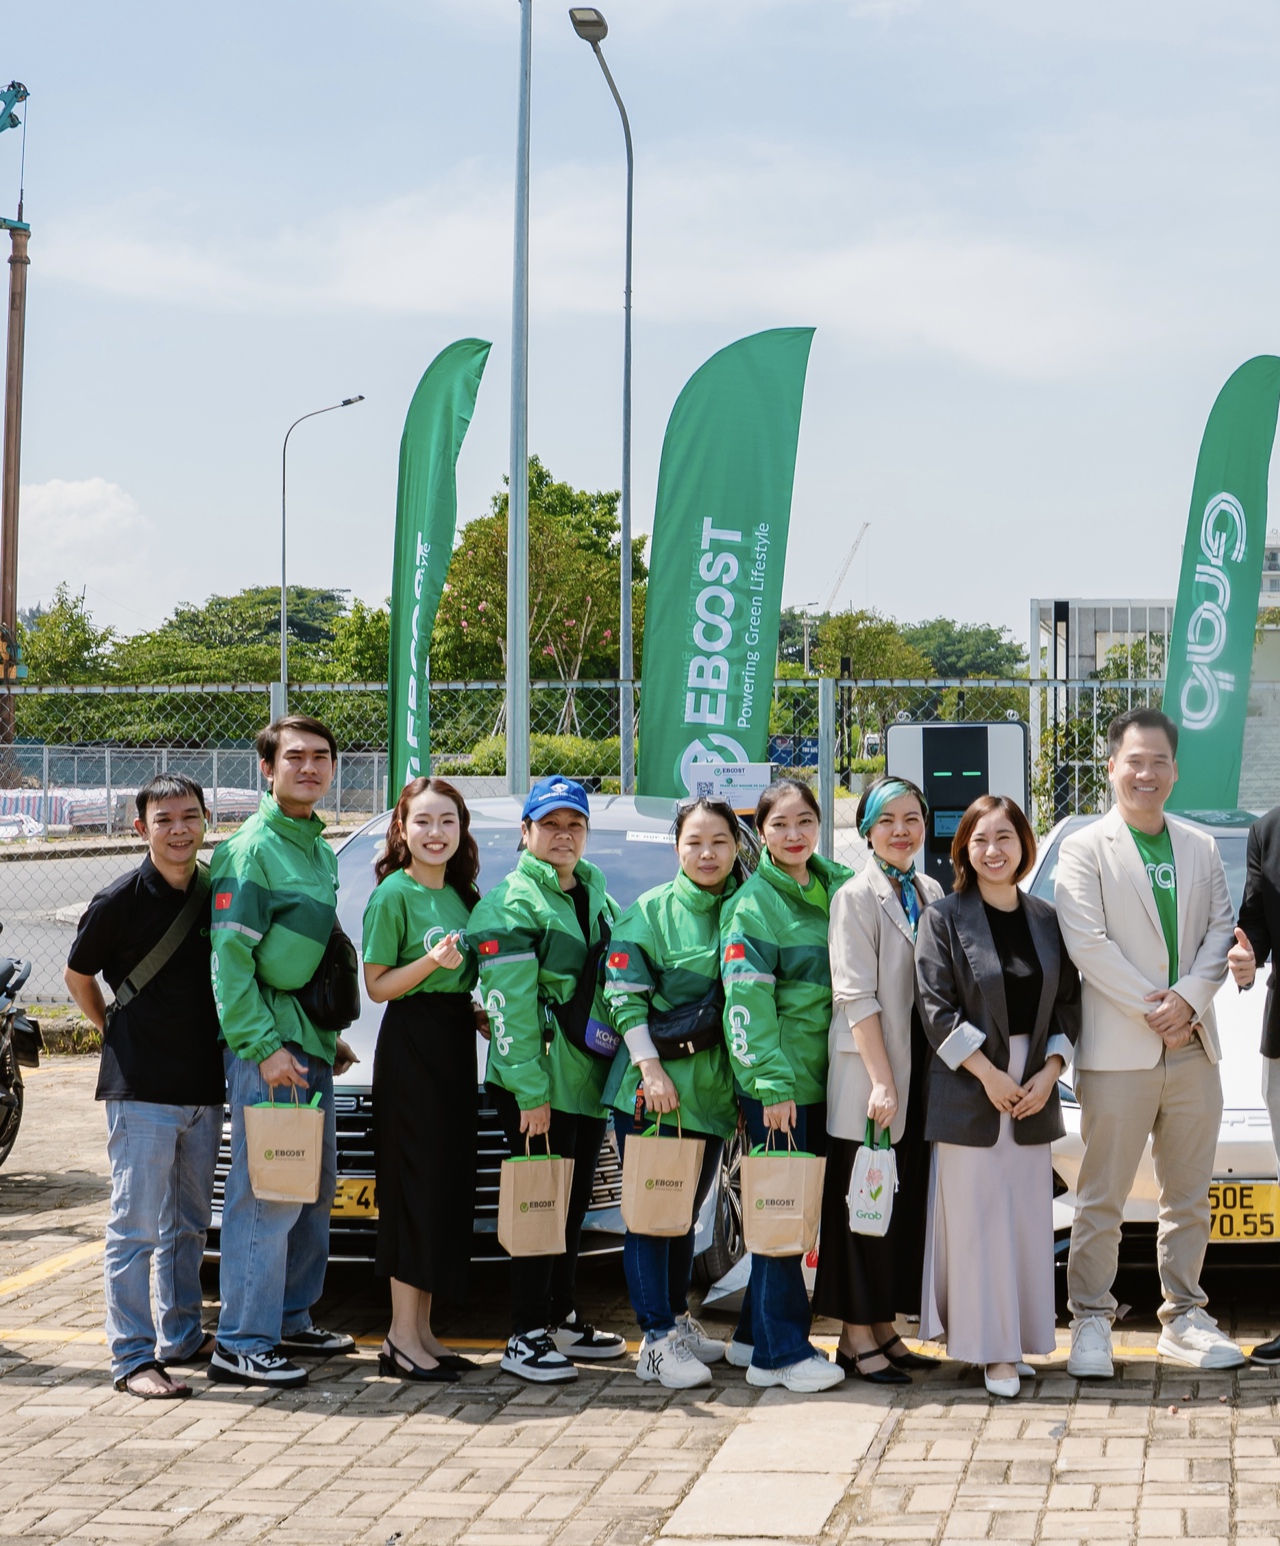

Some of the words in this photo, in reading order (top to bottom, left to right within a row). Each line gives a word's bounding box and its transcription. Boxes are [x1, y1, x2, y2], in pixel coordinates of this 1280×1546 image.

[749, 522, 771, 592] Lifestyle
[684, 516, 742, 726] EBOOST
[745, 597, 762, 646] Green
[1180, 491, 1247, 730] Grab
[737, 651, 760, 729] Powering
[1145, 862, 1176, 889] ra
[487, 989, 514, 1056] Grab
[275, 1149, 306, 1157] EBOOST
[655, 1179, 684, 1188] EBOOST
[529, 1200, 556, 1208] EBOOST
[765, 1199, 796, 1207] EBOOST
[855, 1209, 883, 1220] Grab
